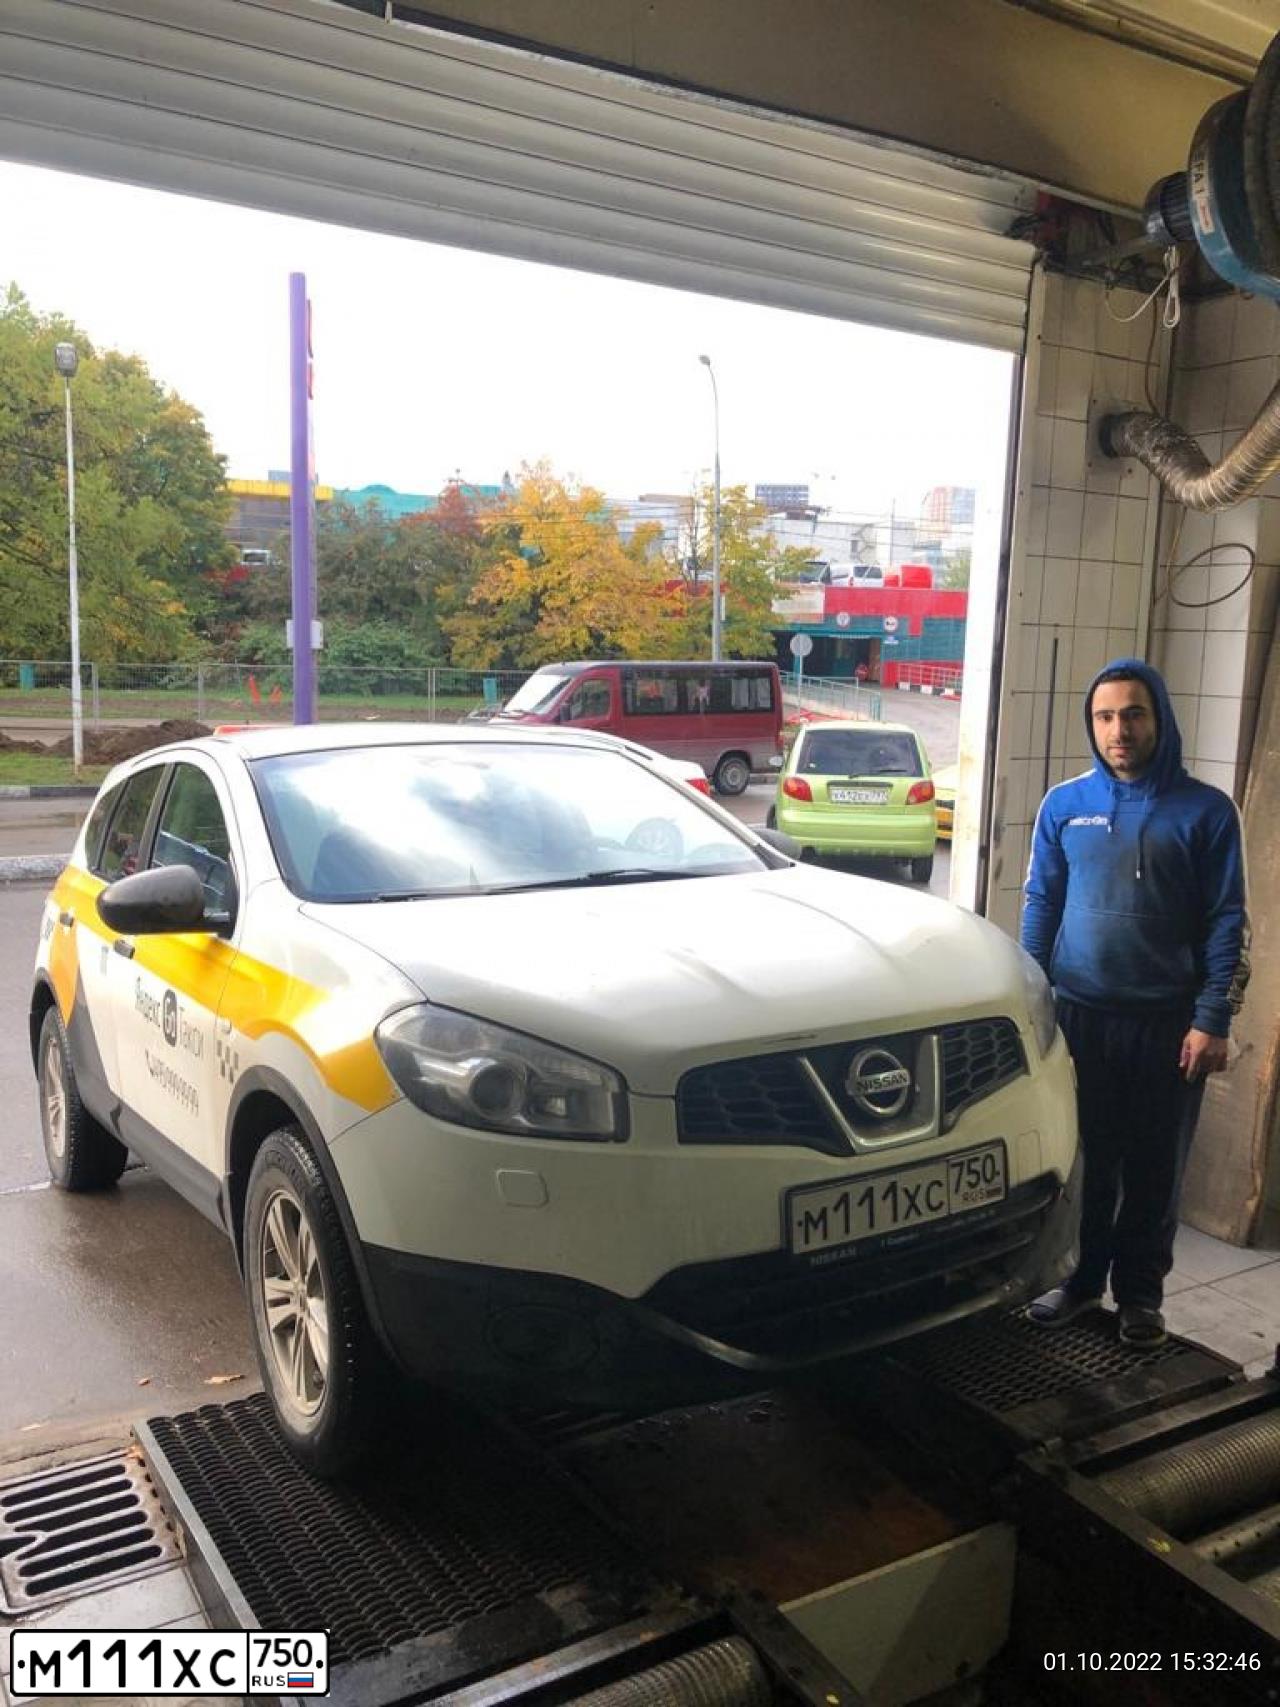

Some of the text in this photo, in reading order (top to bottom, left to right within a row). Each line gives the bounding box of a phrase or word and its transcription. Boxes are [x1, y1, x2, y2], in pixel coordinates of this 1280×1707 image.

[856, 1070, 907, 1094] NISSAN
[803, 1179, 944, 1246] М111ХС
[951, 1153, 997, 1195] 750
